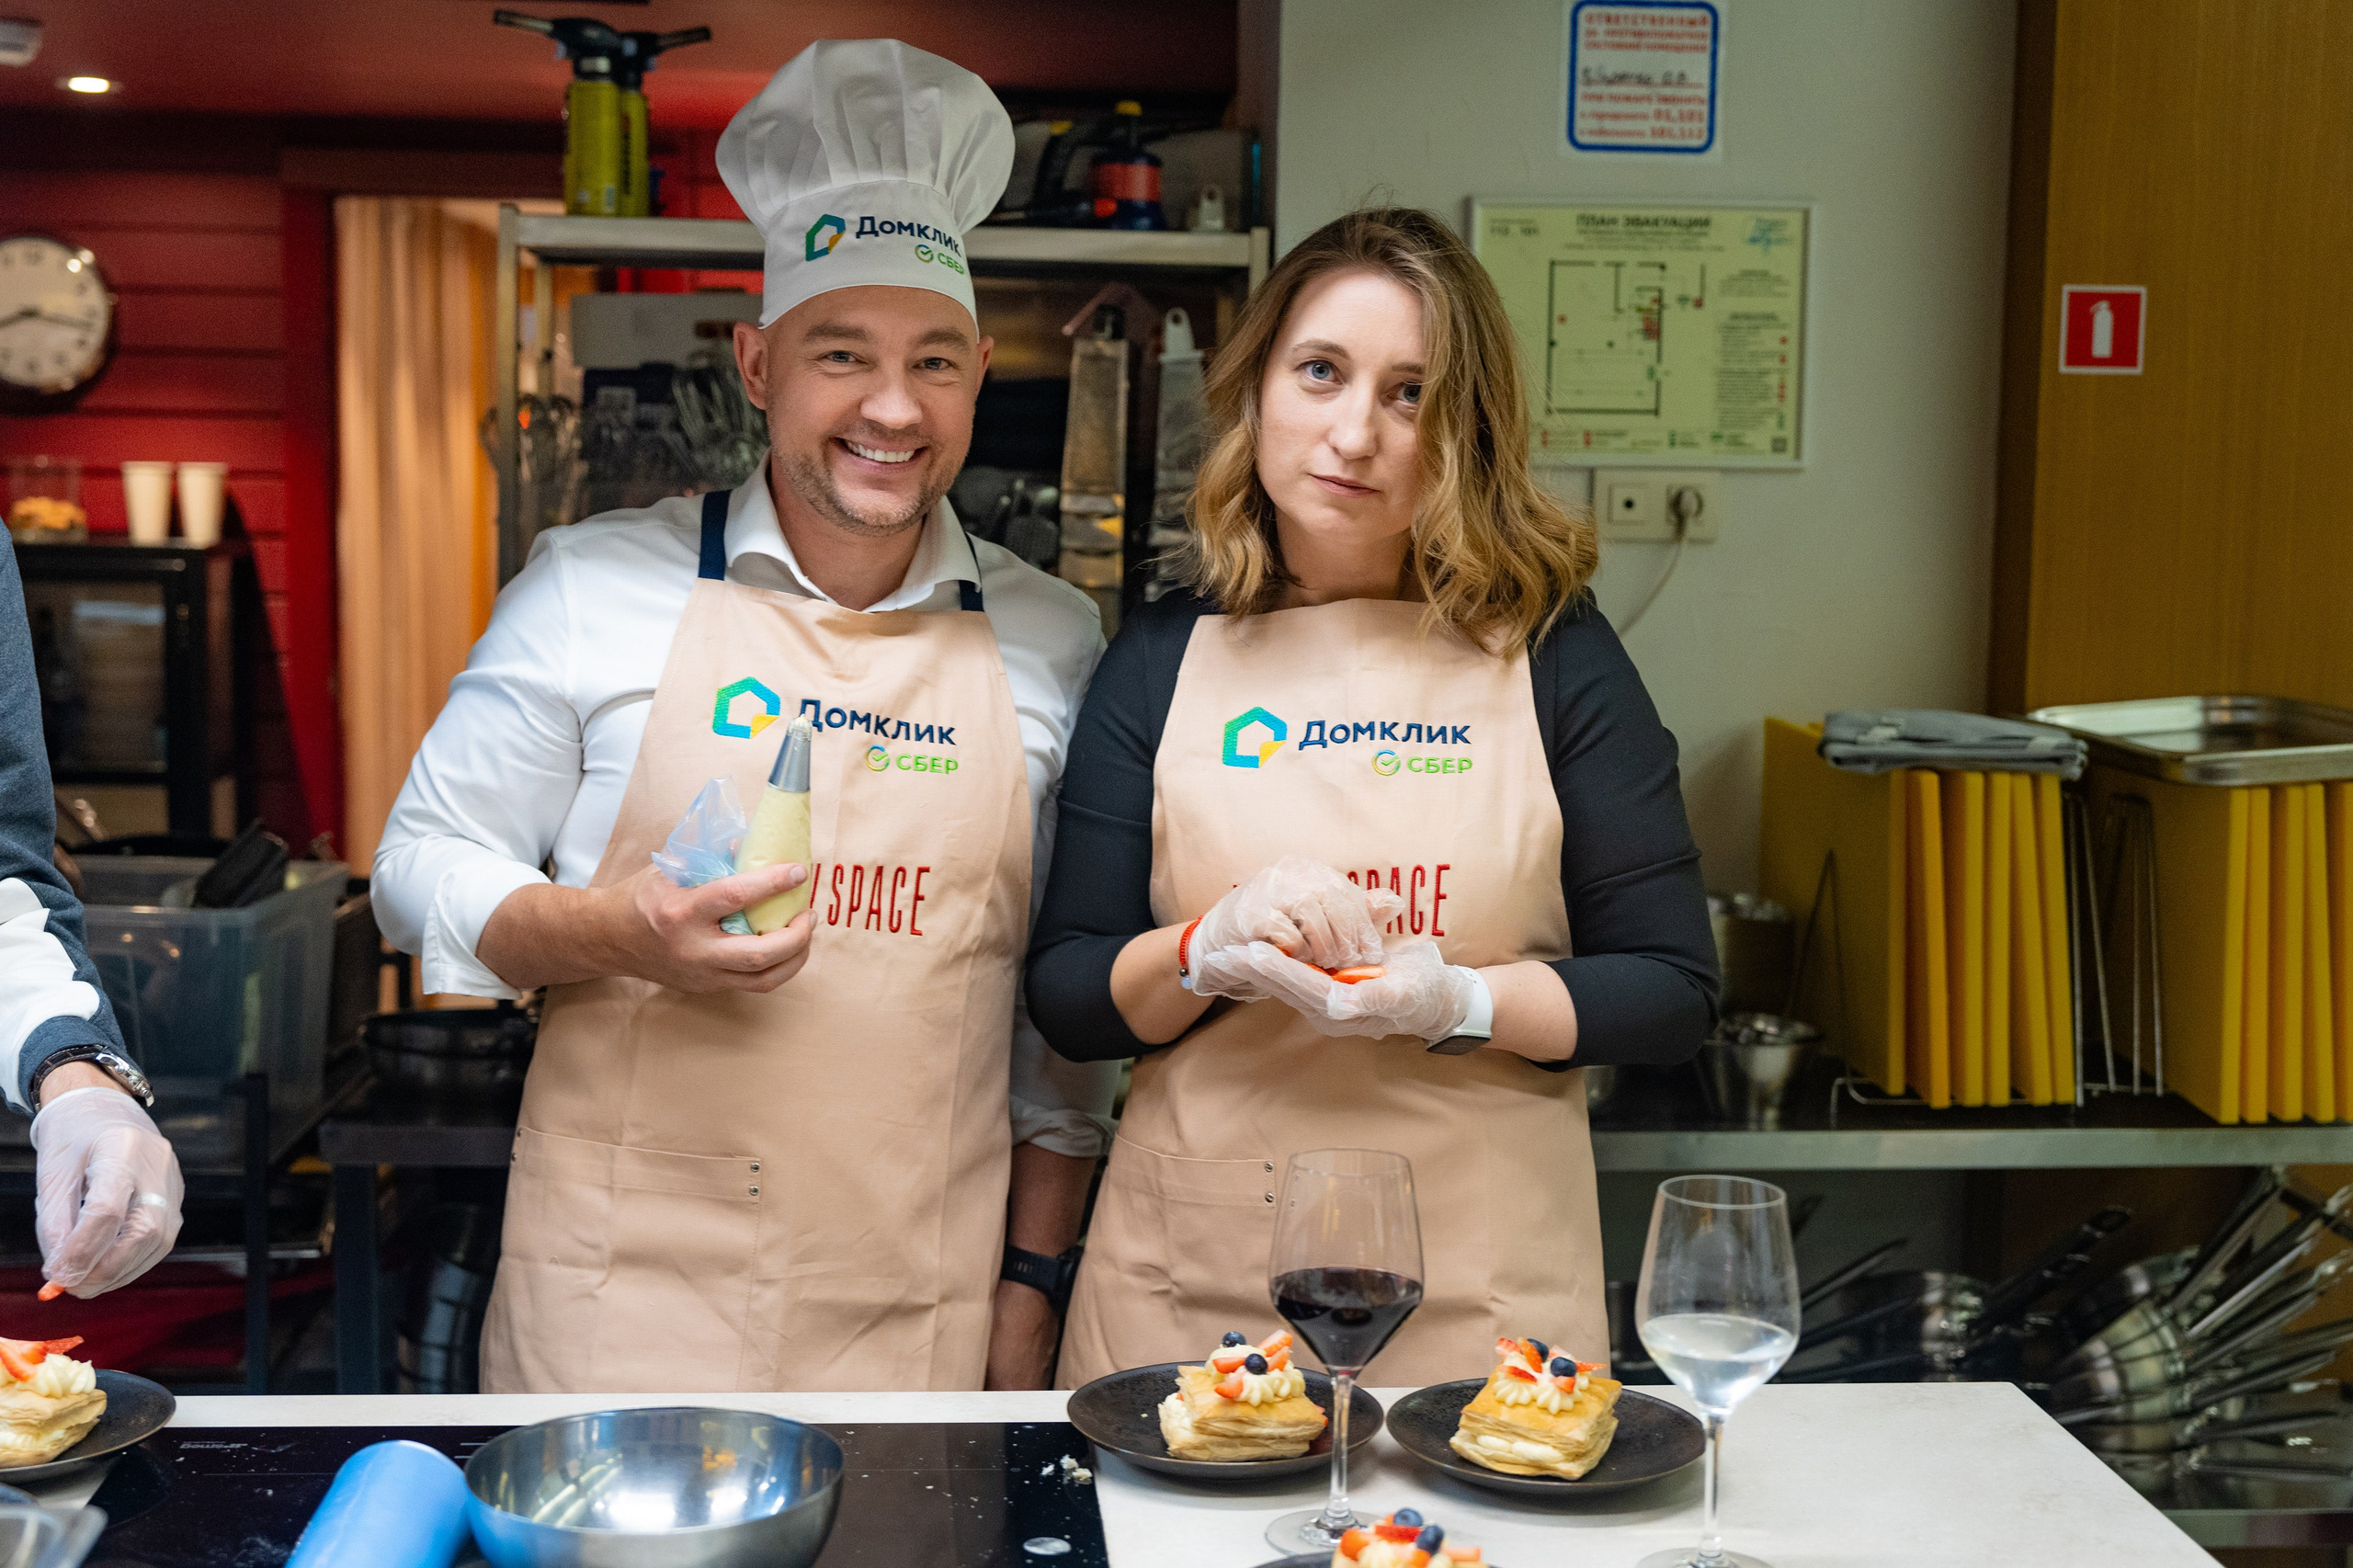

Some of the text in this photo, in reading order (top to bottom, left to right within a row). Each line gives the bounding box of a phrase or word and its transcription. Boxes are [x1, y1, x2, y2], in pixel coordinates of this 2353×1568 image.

[1576, 212, 1619, 226] ПЛАН
[896, 754, 959, 775] СБЕР
[1407, 756, 1473, 774] СБЕР
[1347, 864, 1450, 937] ACE
